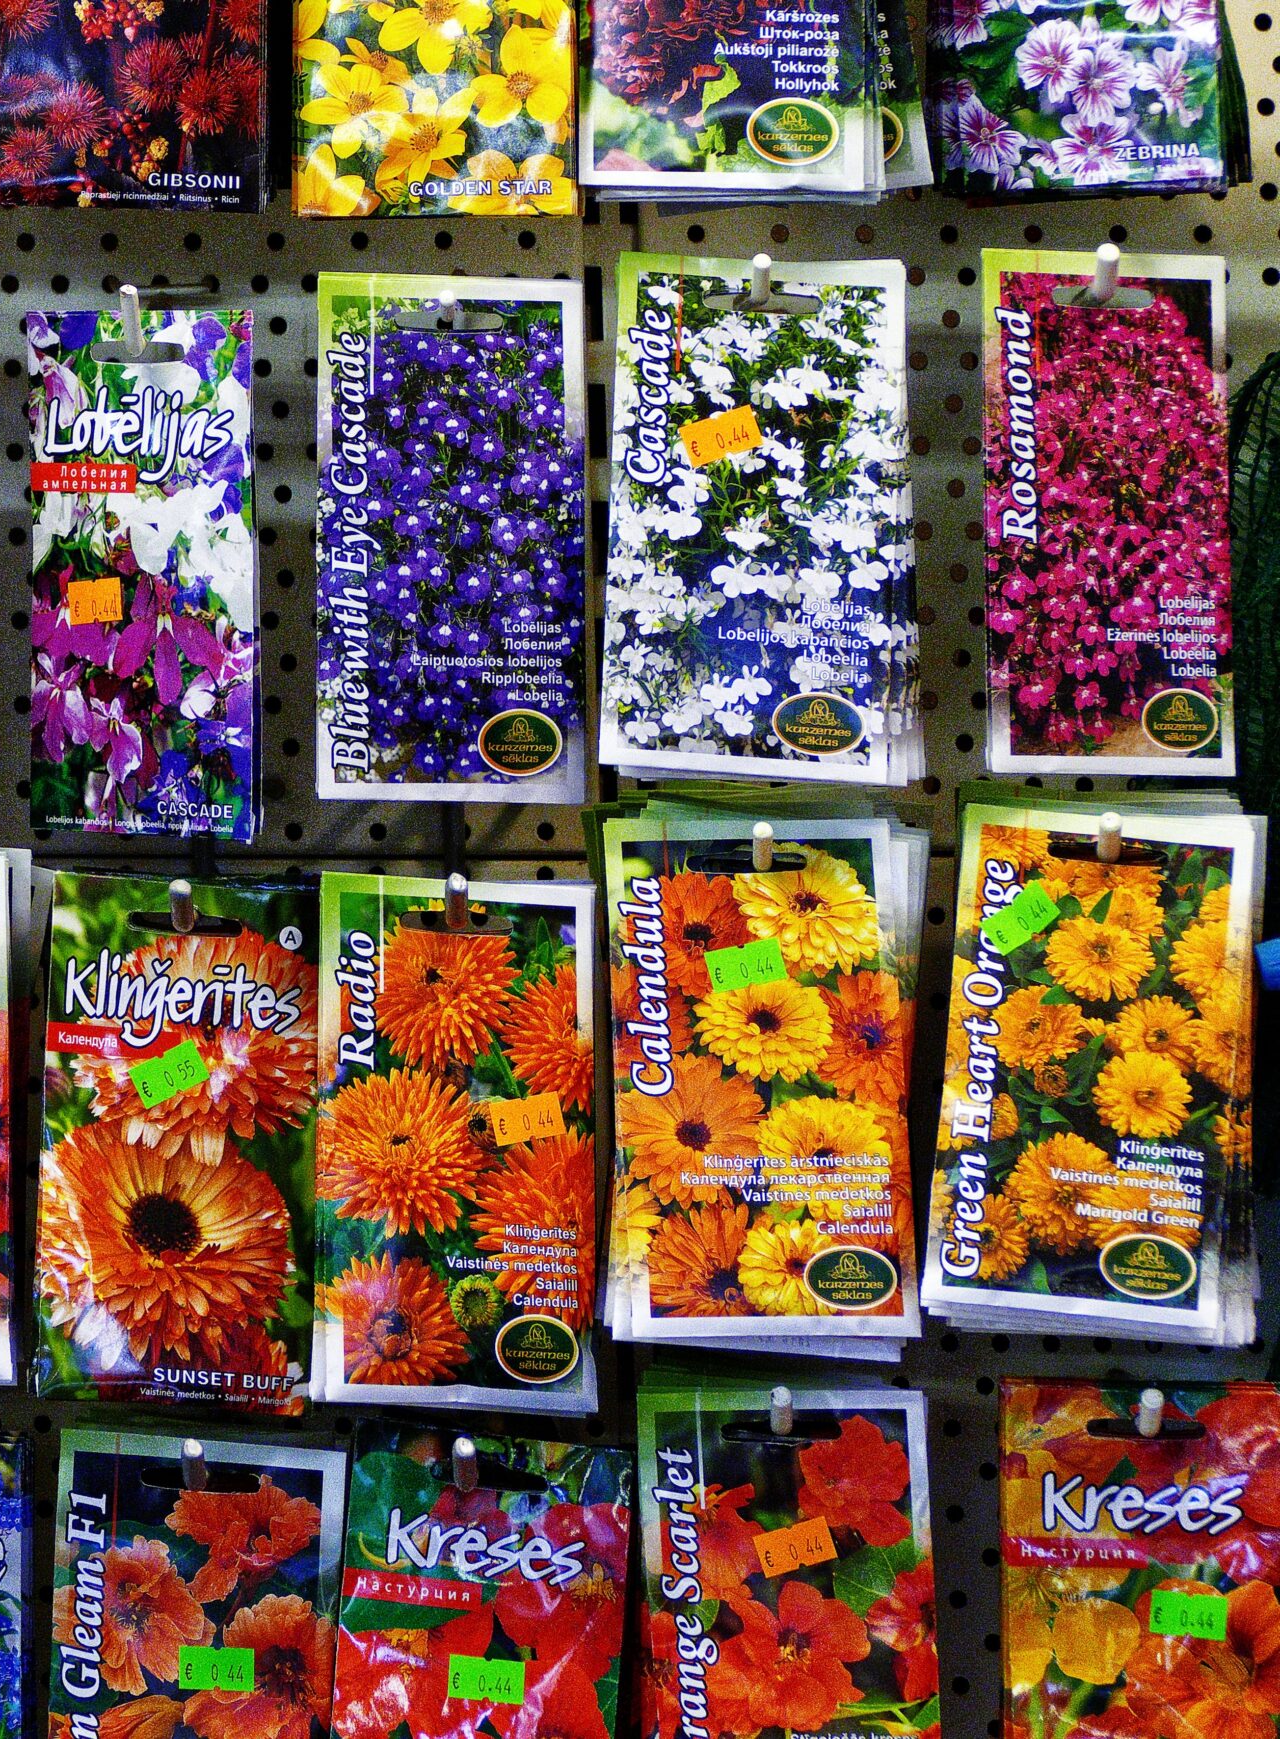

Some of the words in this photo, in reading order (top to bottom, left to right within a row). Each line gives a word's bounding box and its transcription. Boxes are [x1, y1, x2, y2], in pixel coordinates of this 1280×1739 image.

[765, 10, 840, 24] Kāršrozes
[759, 26, 840, 41] Шток-роза
[713, 42, 773, 58] Aukštoji
[772, 60, 839, 74] Tokkroos
[774, 77, 839, 92] Hollyhok
[1114, 143, 1200, 162] ZEBRINA
[147, 172, 241, 190] GIBSONII
[409, 181, 492, 196] GOLDEN
[498, 180, 552, 195] STAR
[221, 194, 239, 203] Ricin
[624, 309, 673, 486] Cascade
[326, 332, 370, 495] Cascade
[44, 385, 234, 482] Lobēlijas
[995, 306, 1039, 545] Rosamond
[61, 467, 128, 478] Лобелия
[43, 480, 128, 492] ампельная
[330, 499, 381, 578] Eye
[802, 599, 872, 620] Lobēlijas
[1160, 596, 1215, 611] Lobēlijas
[504, 621, 562, 635] Lobēlijas
[800, 616, 871, 634] Лобелия
[1159, 613, 1215, 626] Лобелия
[327, 585, 370, 674] with
[1162, 629, 1216, 644] lobelijos
[504, 638, 562, 651] Лобелия
[718, 627, 787, 646] Lobelijos
[790, 632, 870, 651] kabančios
[412, 654, 504, 669] Laiptuotosios
[508, 654, 562, 670] lobelijos
[803, 649, 869, 667] Lobeelia
[1163, 647, 1216, 660] Lobeelia
[482, 671, 563, 687] Ripplobeelia
[811, 666, 869, 684] Lobelia
[1171, 663, 1217, 677] Lobelia
[514, 689, 563, 702] Lobelia
[328, 678, 371, 776] Blue
[157, 801, 234, 820] CASCADE
[285, 931, 296, 945] A
[618, 877, 674, 1097] Calendula
[63, 948, 302, 1048] Kliņģerītes
[336, 929, 378, 1070] Radio
[58, 1031, 118, 1049] Календула
[951, 1014, 1001, 1143] Heart
[681, 1172, 765, 1187] Календула
[769, 1173, 890, 1190] лекарственная
[1123, 1177, 1202, 1196] medetkos
[815, 1188, 892, 1204] medetkos
[842, 1203, 893, 1221] Saialill
[940, 1153, 988, 1280] Green
[1075, 1202, 1148, 1225] Marigold
[1151, 1210, 1200, 1229] Green
[815, 1220, 894, 1238] Calendula
[503, 1241, 577, 1259] Календула
[512, 1258, 577, 1274] medetkos
[536, 1277, 578, 1292] Saialill
[513, 1294, 578, 1309] Calendula
[153, 1367, 234, 1389] SUNSET
[242, 1373, 294, 1393] BUFF
[1041, 1471, 1245, 1535] Kreses
[65, 1491, 108, 1549] F1
[653, 1447, 702, 1604] Scarlet
[386, 1507, 586, 1587] Kreses
[1021, 1545, 1135, 1562] Настурция
[357, 1580, 472, 1603] Настурция
[60, 1557, 106, 1698] Gleam
